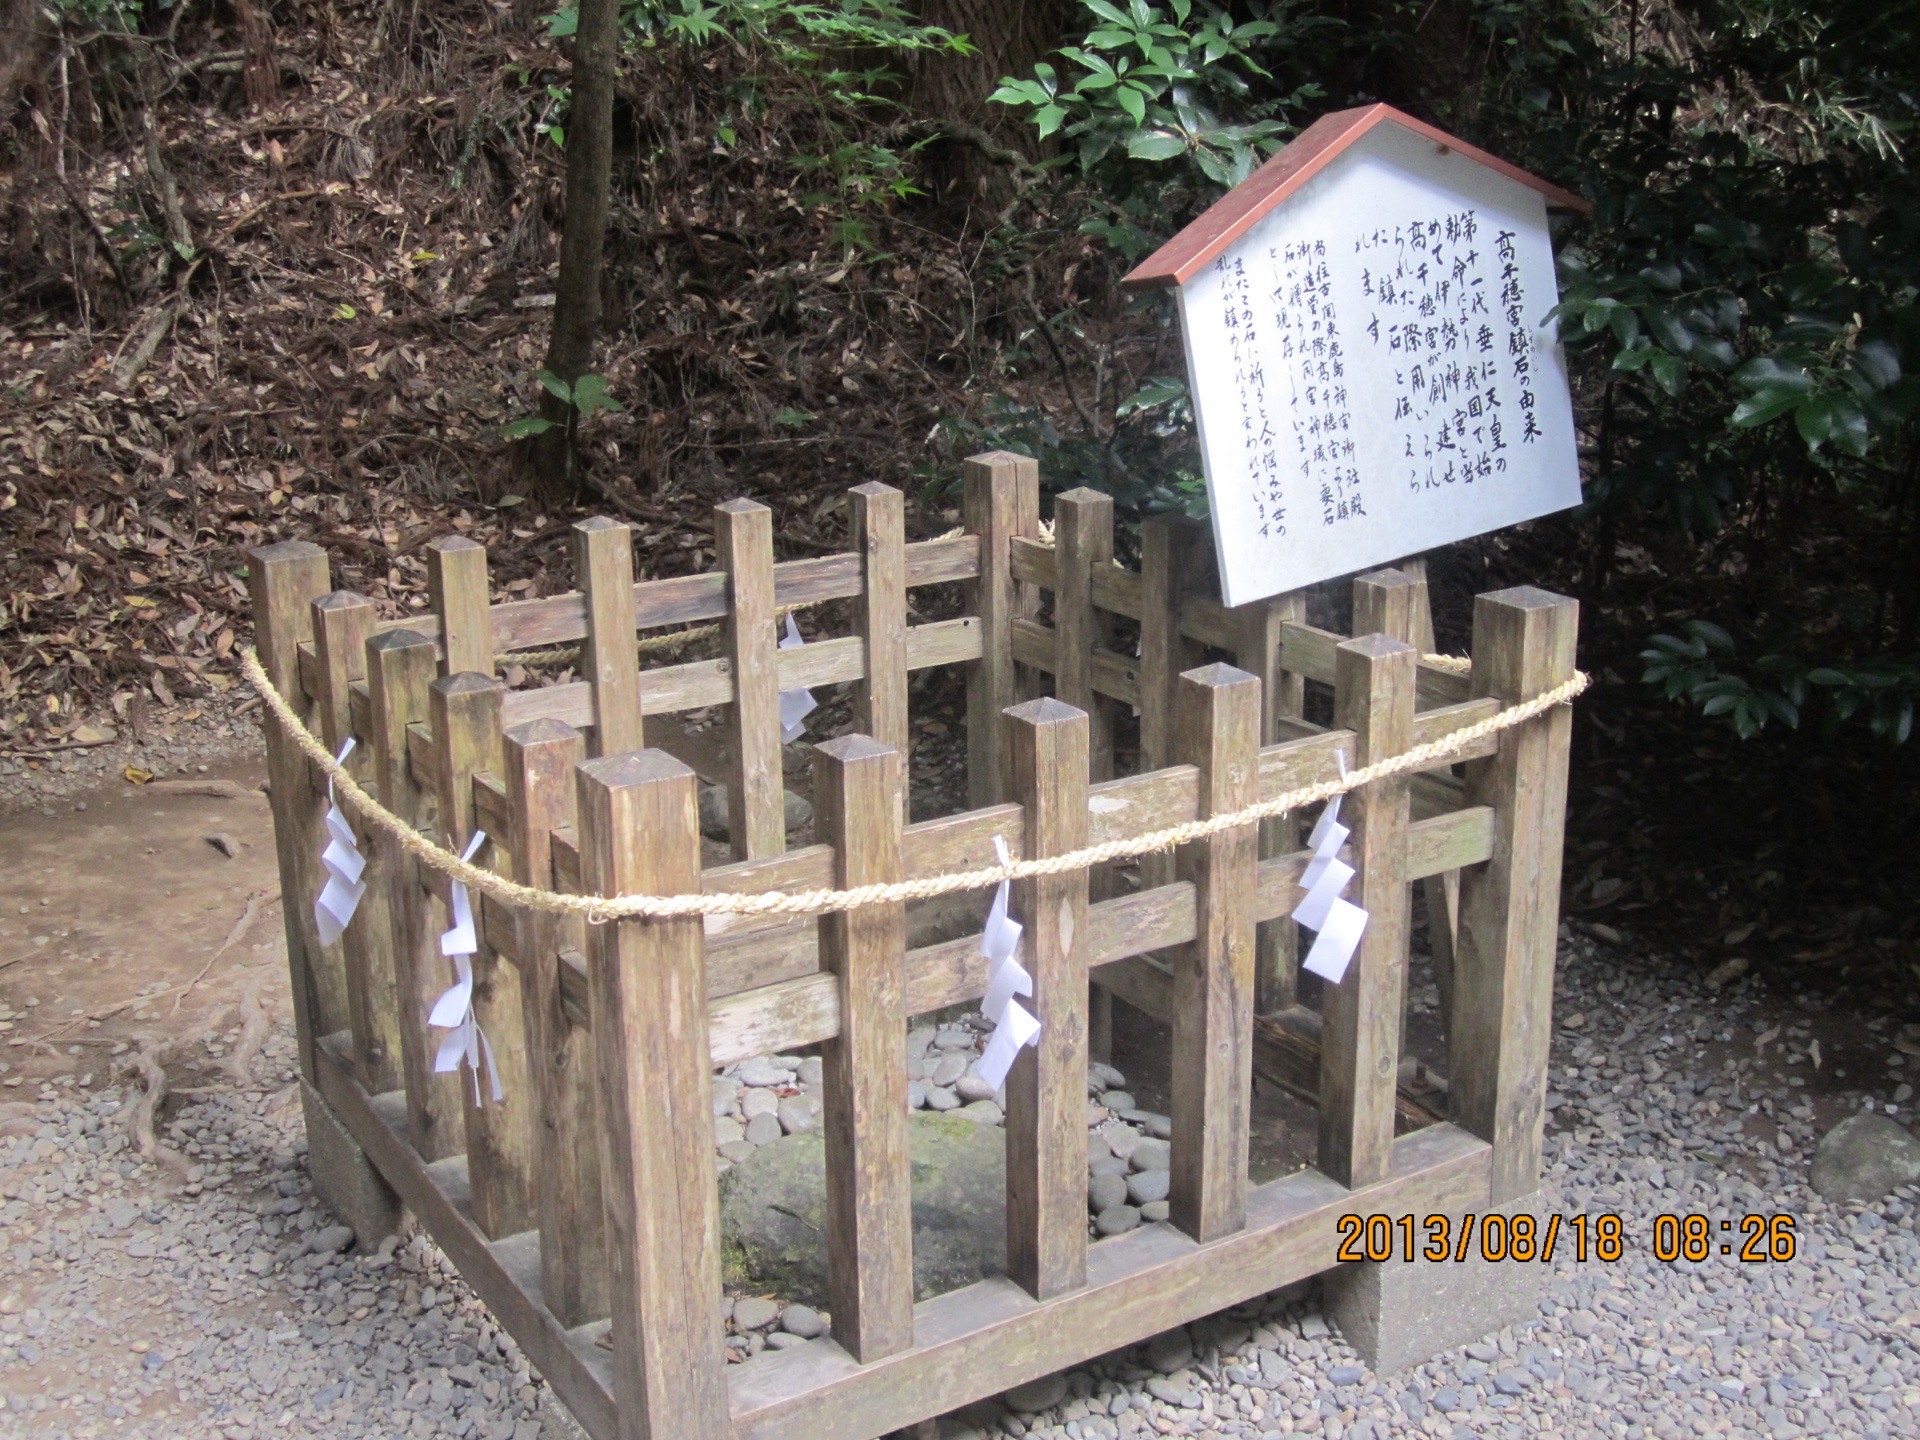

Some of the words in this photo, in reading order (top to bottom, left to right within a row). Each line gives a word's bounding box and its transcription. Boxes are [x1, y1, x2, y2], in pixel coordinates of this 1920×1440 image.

[1355, 233, 1380, 345] れます
[1372, 228, 1420, 493] た鎮石と伝えら
[1394, 226, 1440, 489] られた際用いられ
[1428, 218, 1474, 484] めて伊勢神宮と当
[1445, 214, 1492, 478] 勅命により我国で始
[1460, 210, 1507, 473] 第十一代垂仁天皇の
